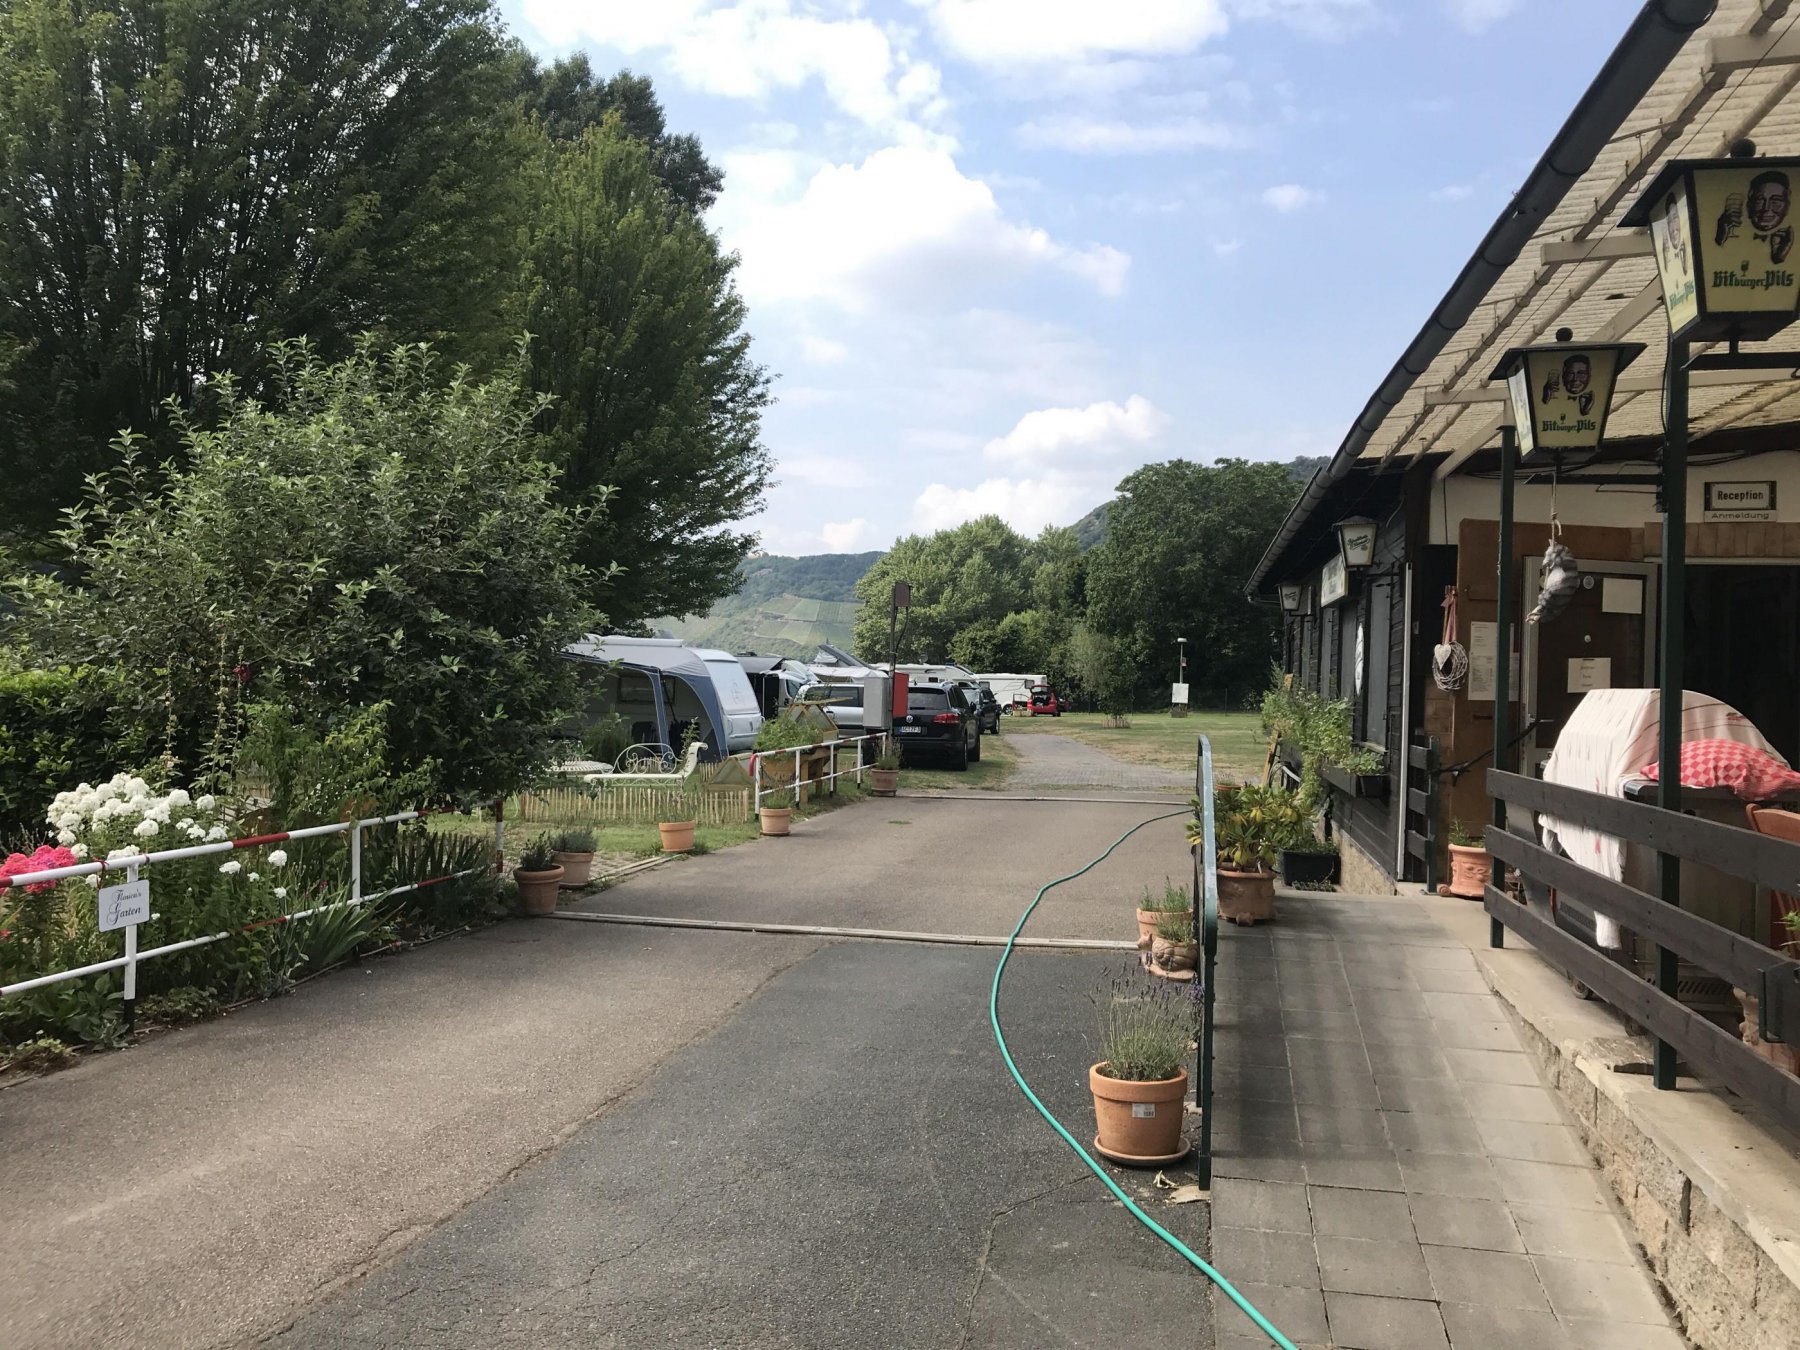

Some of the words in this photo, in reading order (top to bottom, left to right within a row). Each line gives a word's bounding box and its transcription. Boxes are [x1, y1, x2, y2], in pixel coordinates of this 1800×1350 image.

[1717, 490, 1764, 502] Reception
[1711, 512, 1770, 520] Anmeldung
[106, 902, 141, 926] Garten
